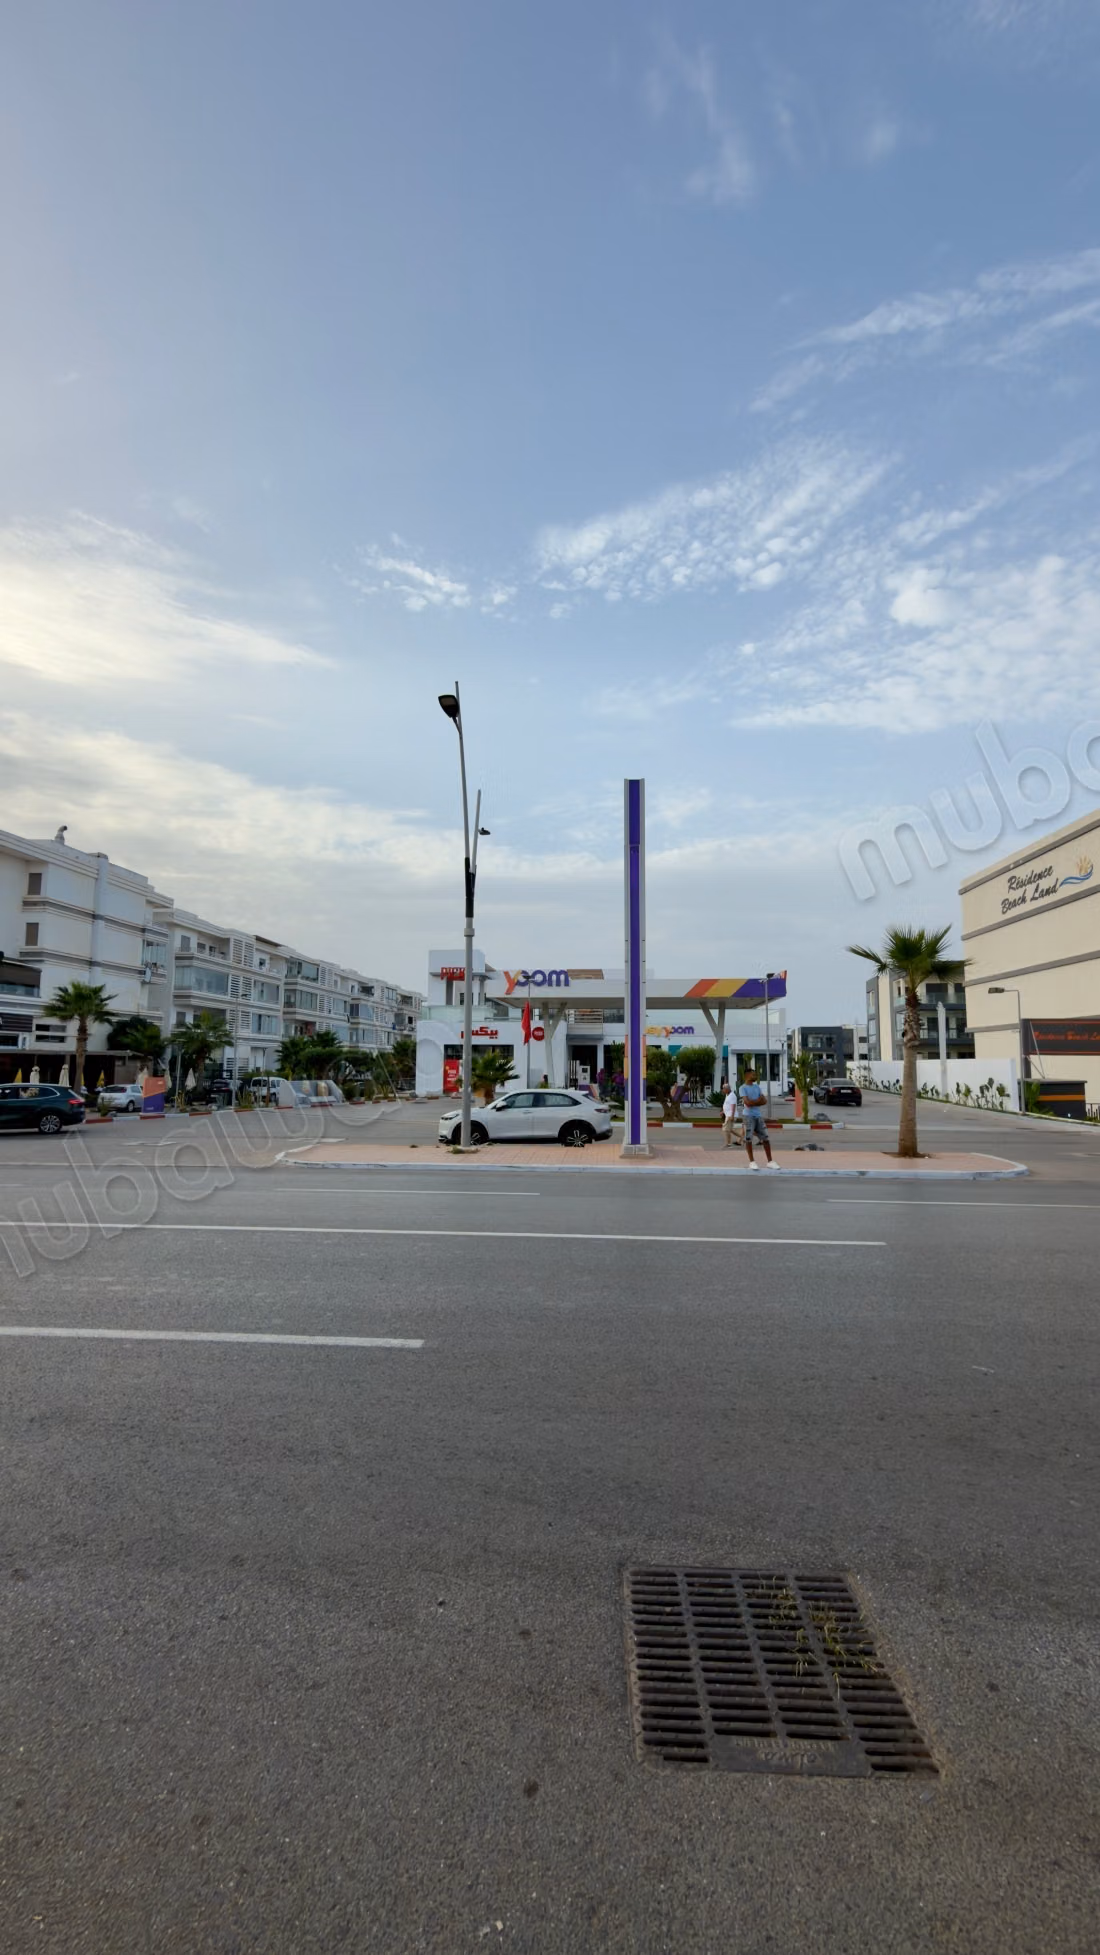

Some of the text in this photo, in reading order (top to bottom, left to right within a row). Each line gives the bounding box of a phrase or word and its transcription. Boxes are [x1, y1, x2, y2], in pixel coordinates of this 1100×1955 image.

[1007, 865, 1054, 894] Résidence
[1001, 877, 1059, 915] Beach Land
[503, 969, 570, 995] yoom
